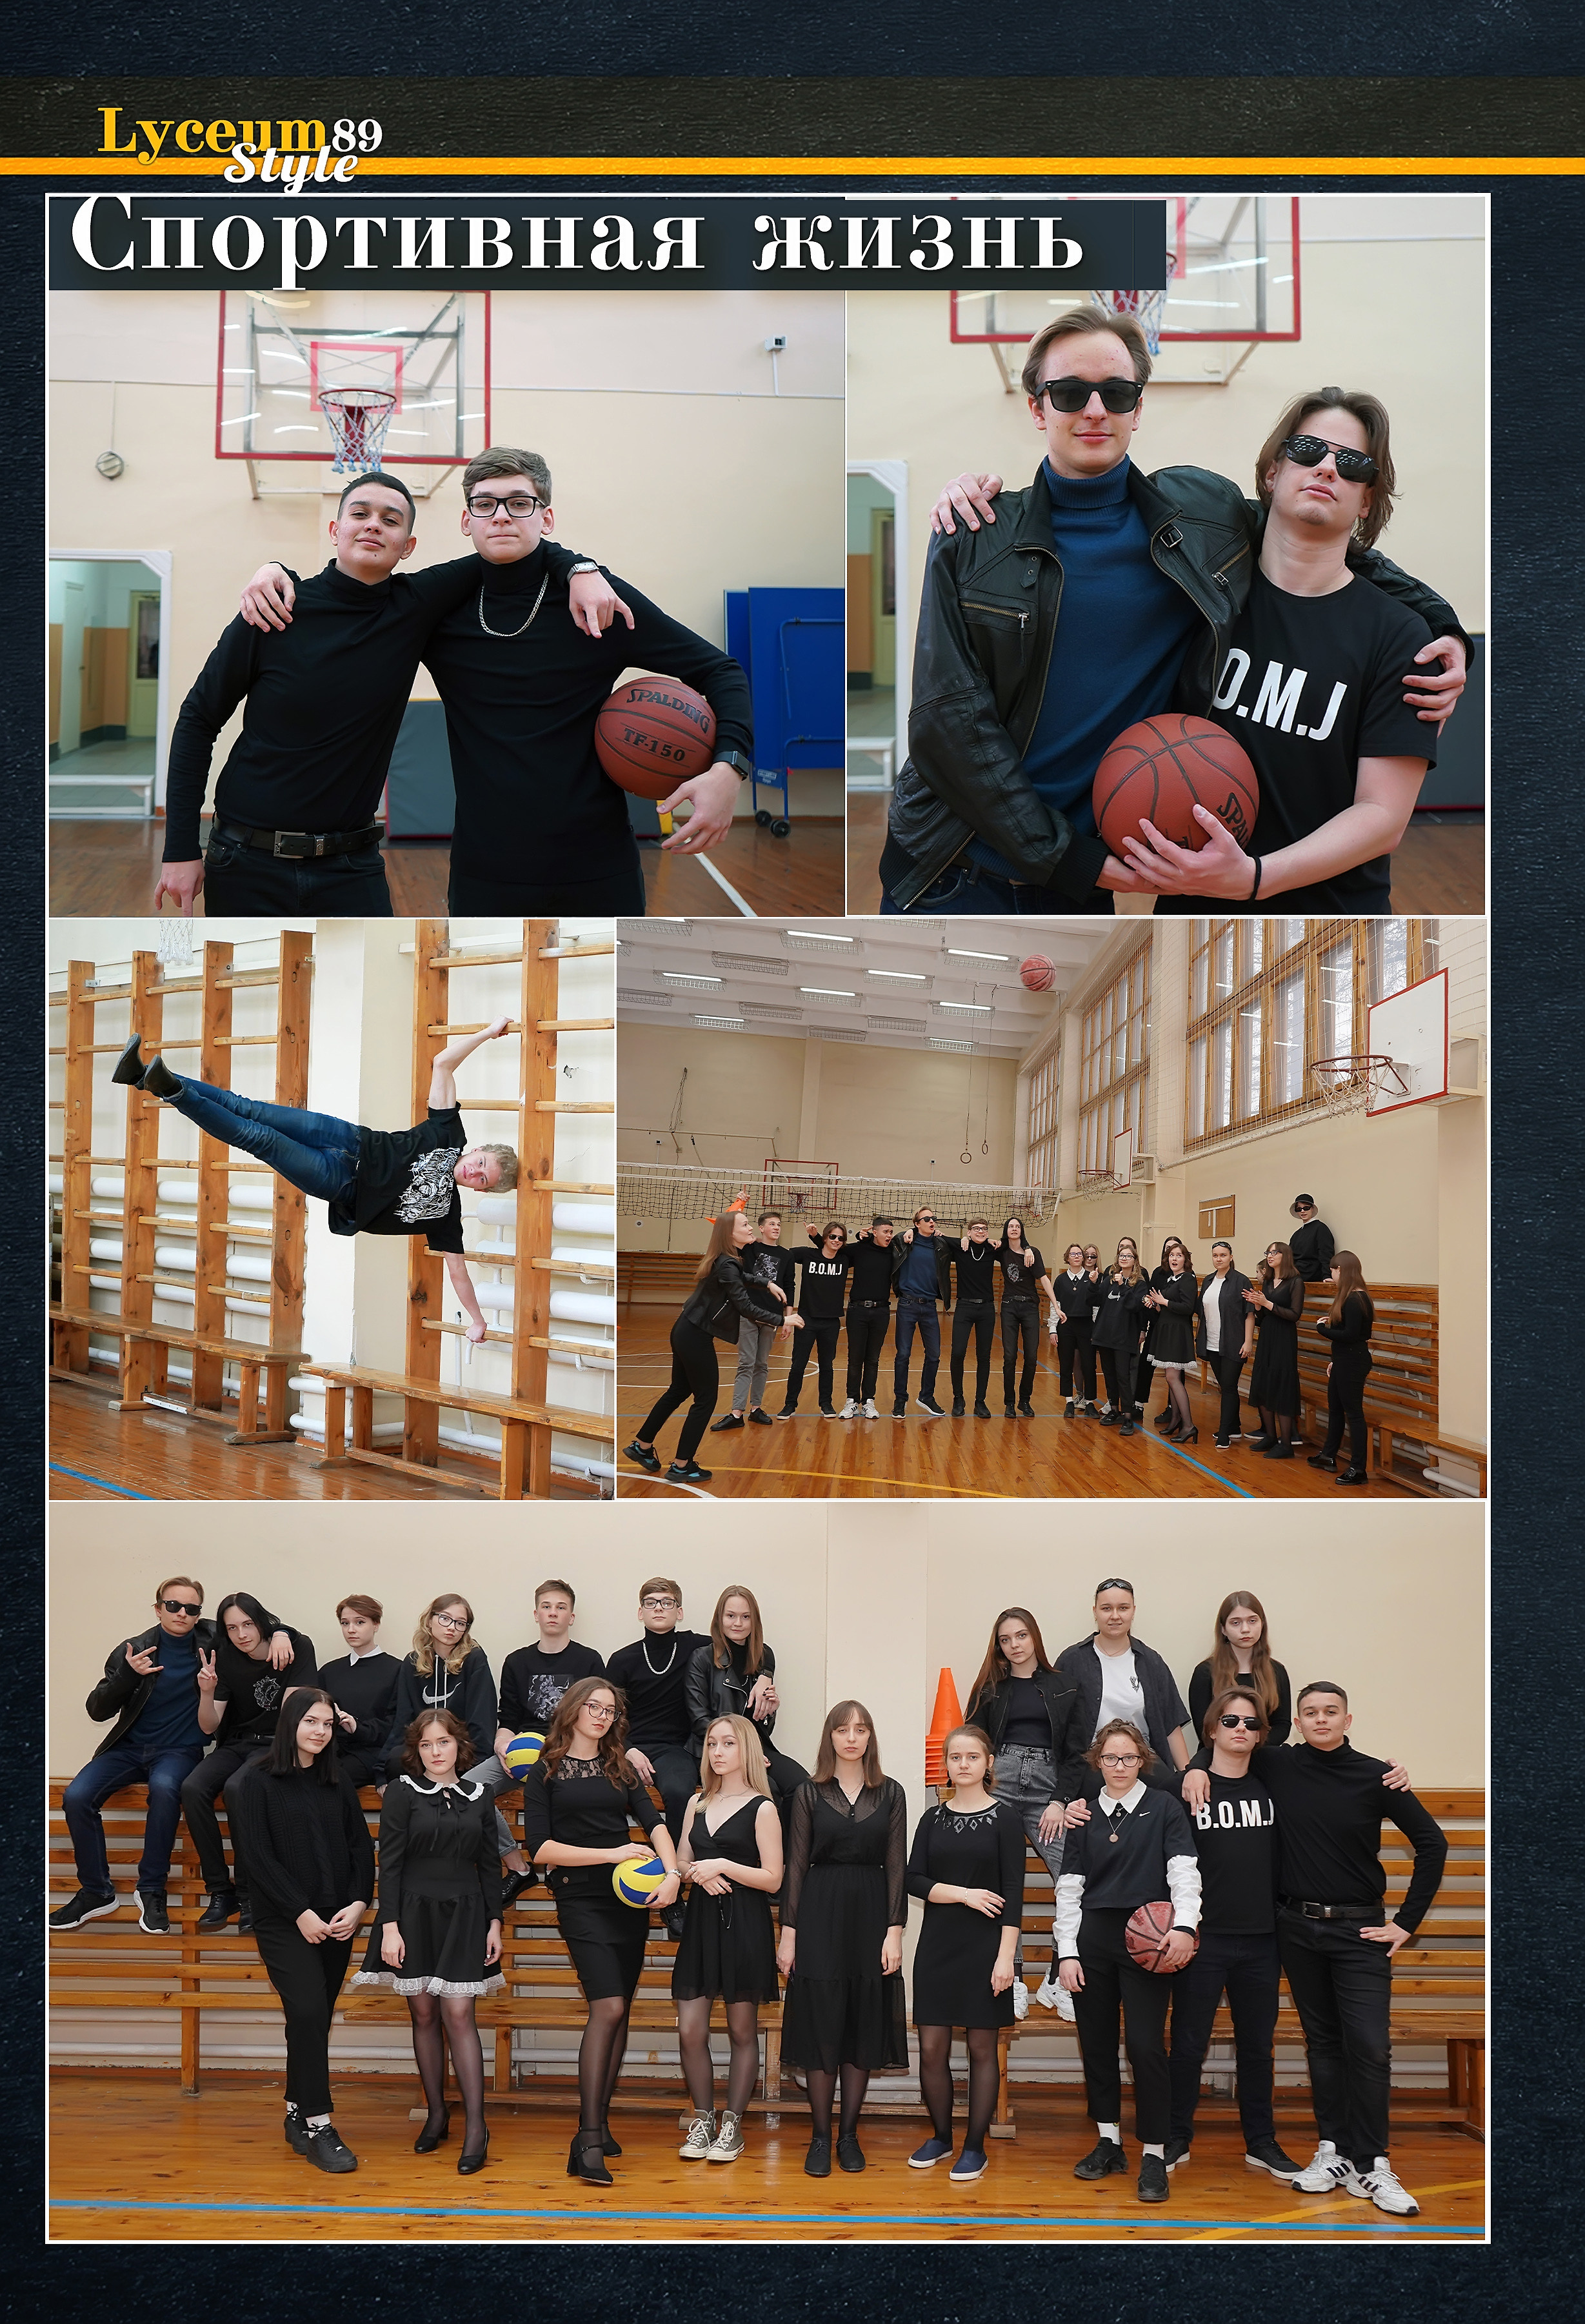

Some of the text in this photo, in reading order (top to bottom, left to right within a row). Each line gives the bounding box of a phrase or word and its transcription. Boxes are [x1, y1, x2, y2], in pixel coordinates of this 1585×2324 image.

[626, 688, 710, 734] SPALDING
[623, 728, 686, 761] TF-150
[808, 1261, 842, 1276] B.O.M.J
